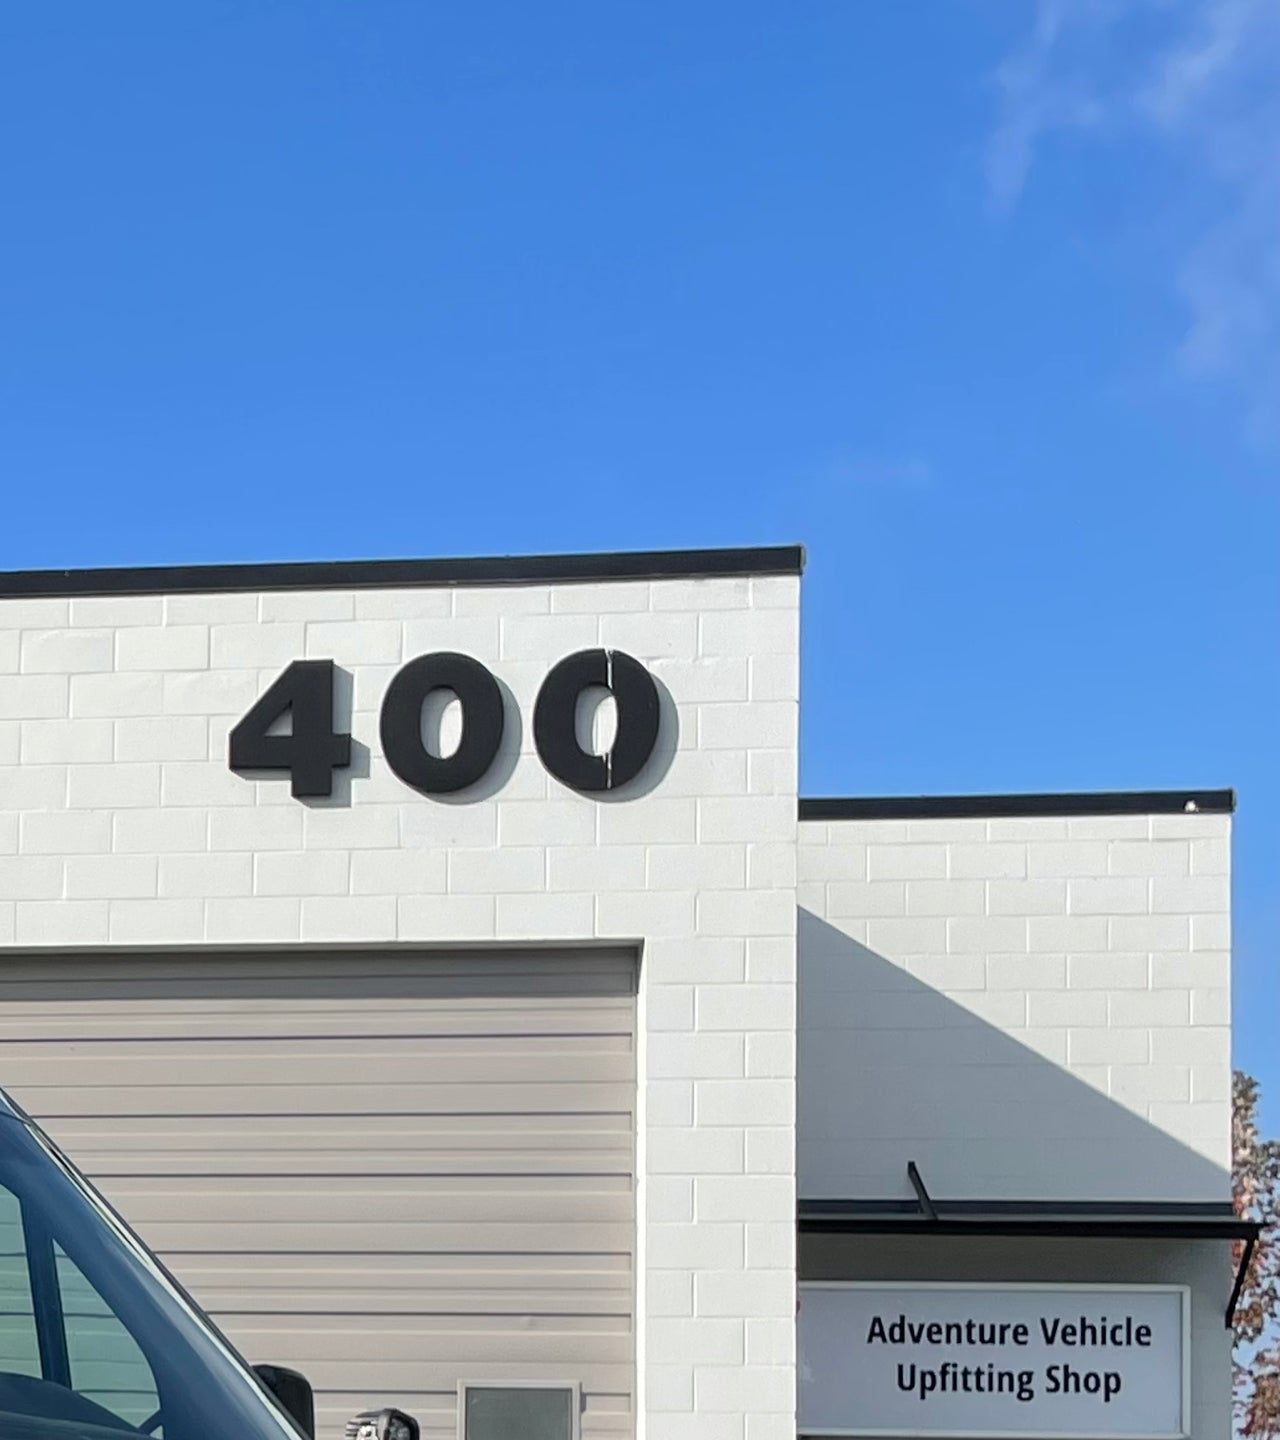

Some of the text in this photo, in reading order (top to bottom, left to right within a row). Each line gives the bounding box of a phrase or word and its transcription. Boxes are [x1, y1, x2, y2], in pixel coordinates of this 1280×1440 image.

[228, 647, 661, 798] 400
[867, 1314, 1153, 1347] Adventure Vehicle
[897, 1362, 1122, 1402] Upfitting Shop
